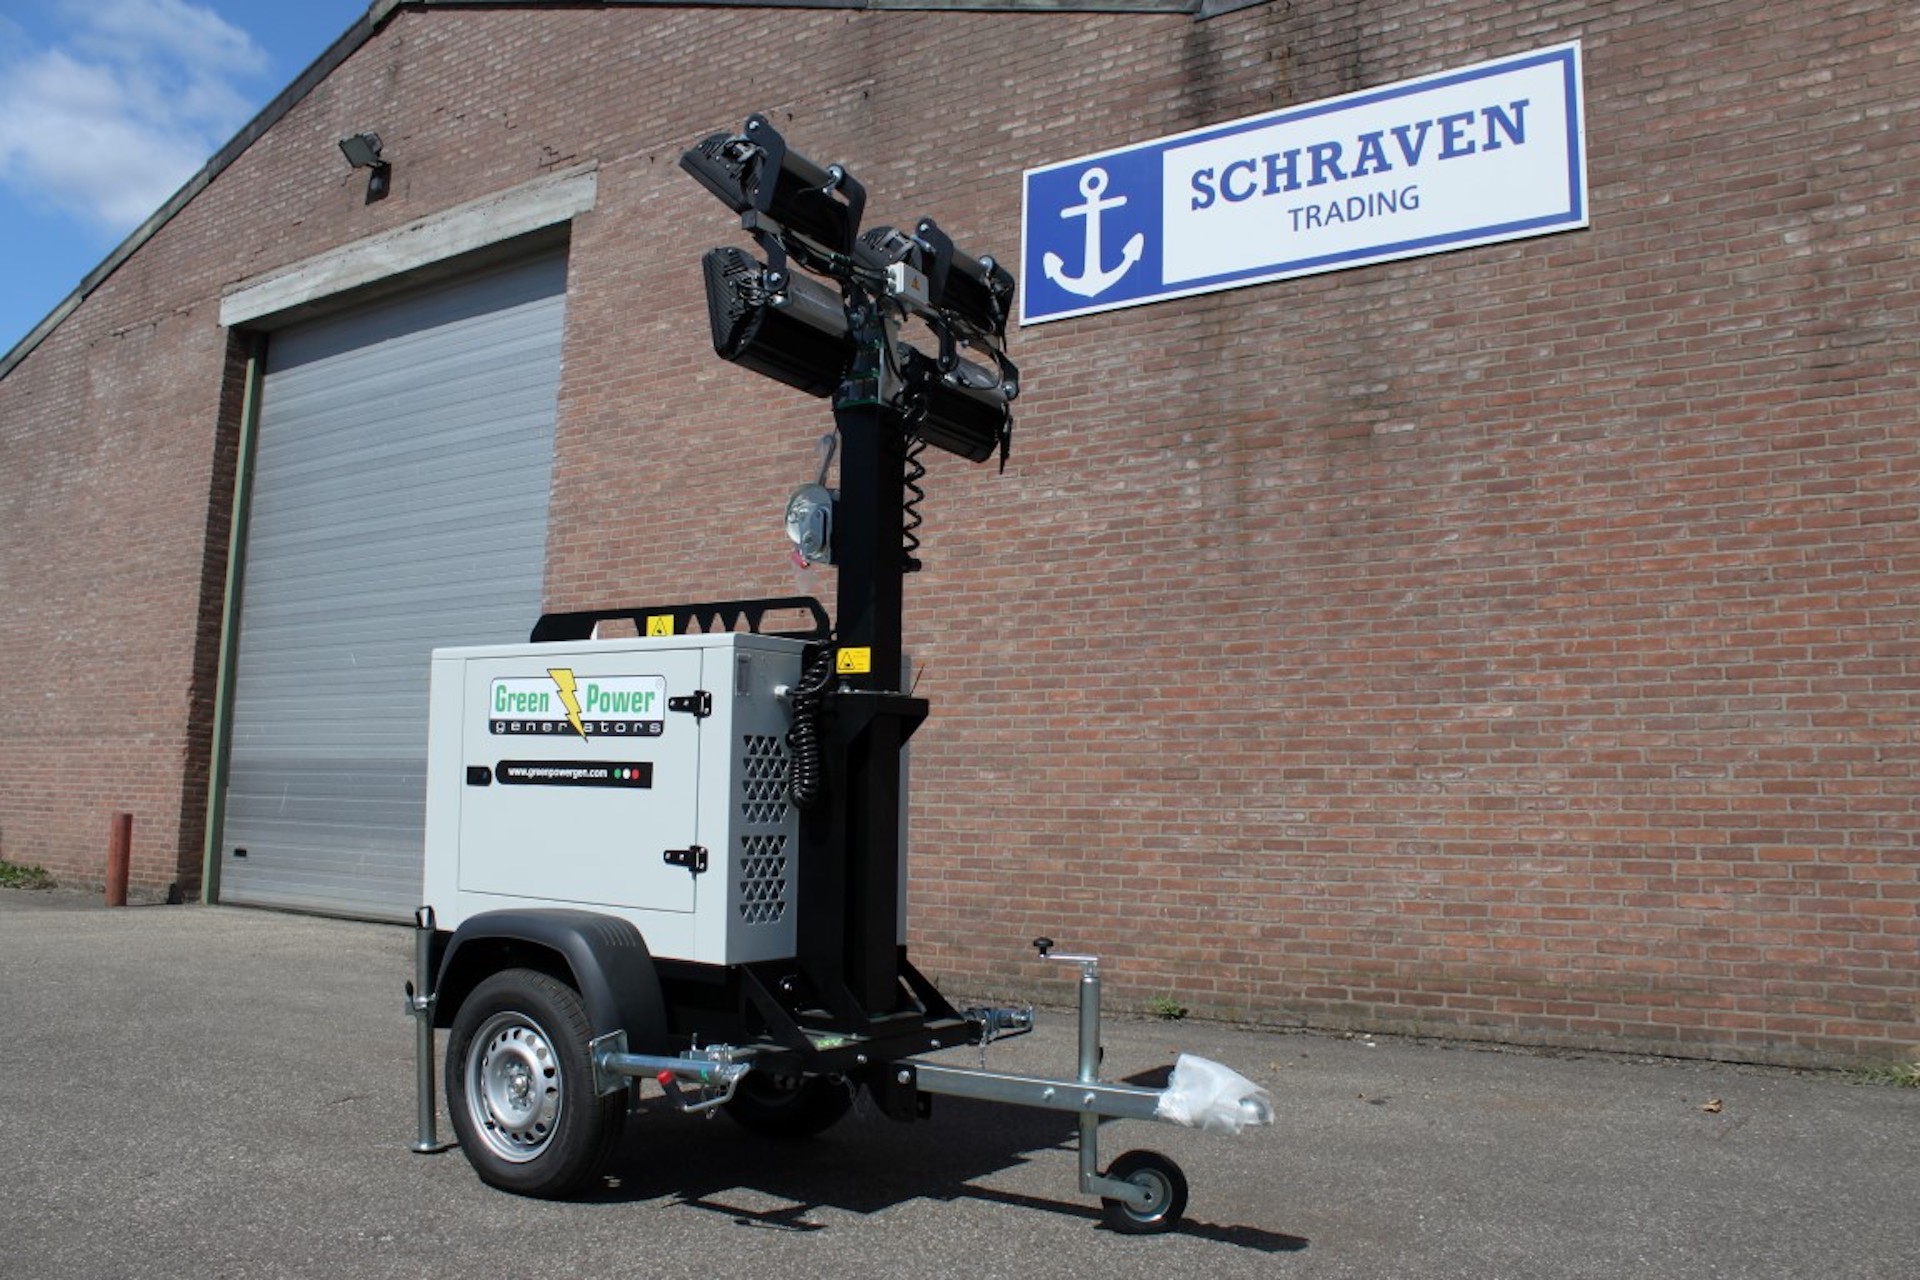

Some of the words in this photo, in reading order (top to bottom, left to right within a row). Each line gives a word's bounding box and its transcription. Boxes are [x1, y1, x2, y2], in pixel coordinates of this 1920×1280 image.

[1191, 99, 1529, 211] SCHRAVEN
[1288, 185, 1420, 232] TRADING
[495, 684, 549, 713] Green
[586, 683, 656, 713] Power
[495, 721, 661, 733] generators
[508, 766, 608, 779] www.greenpowergen.com
